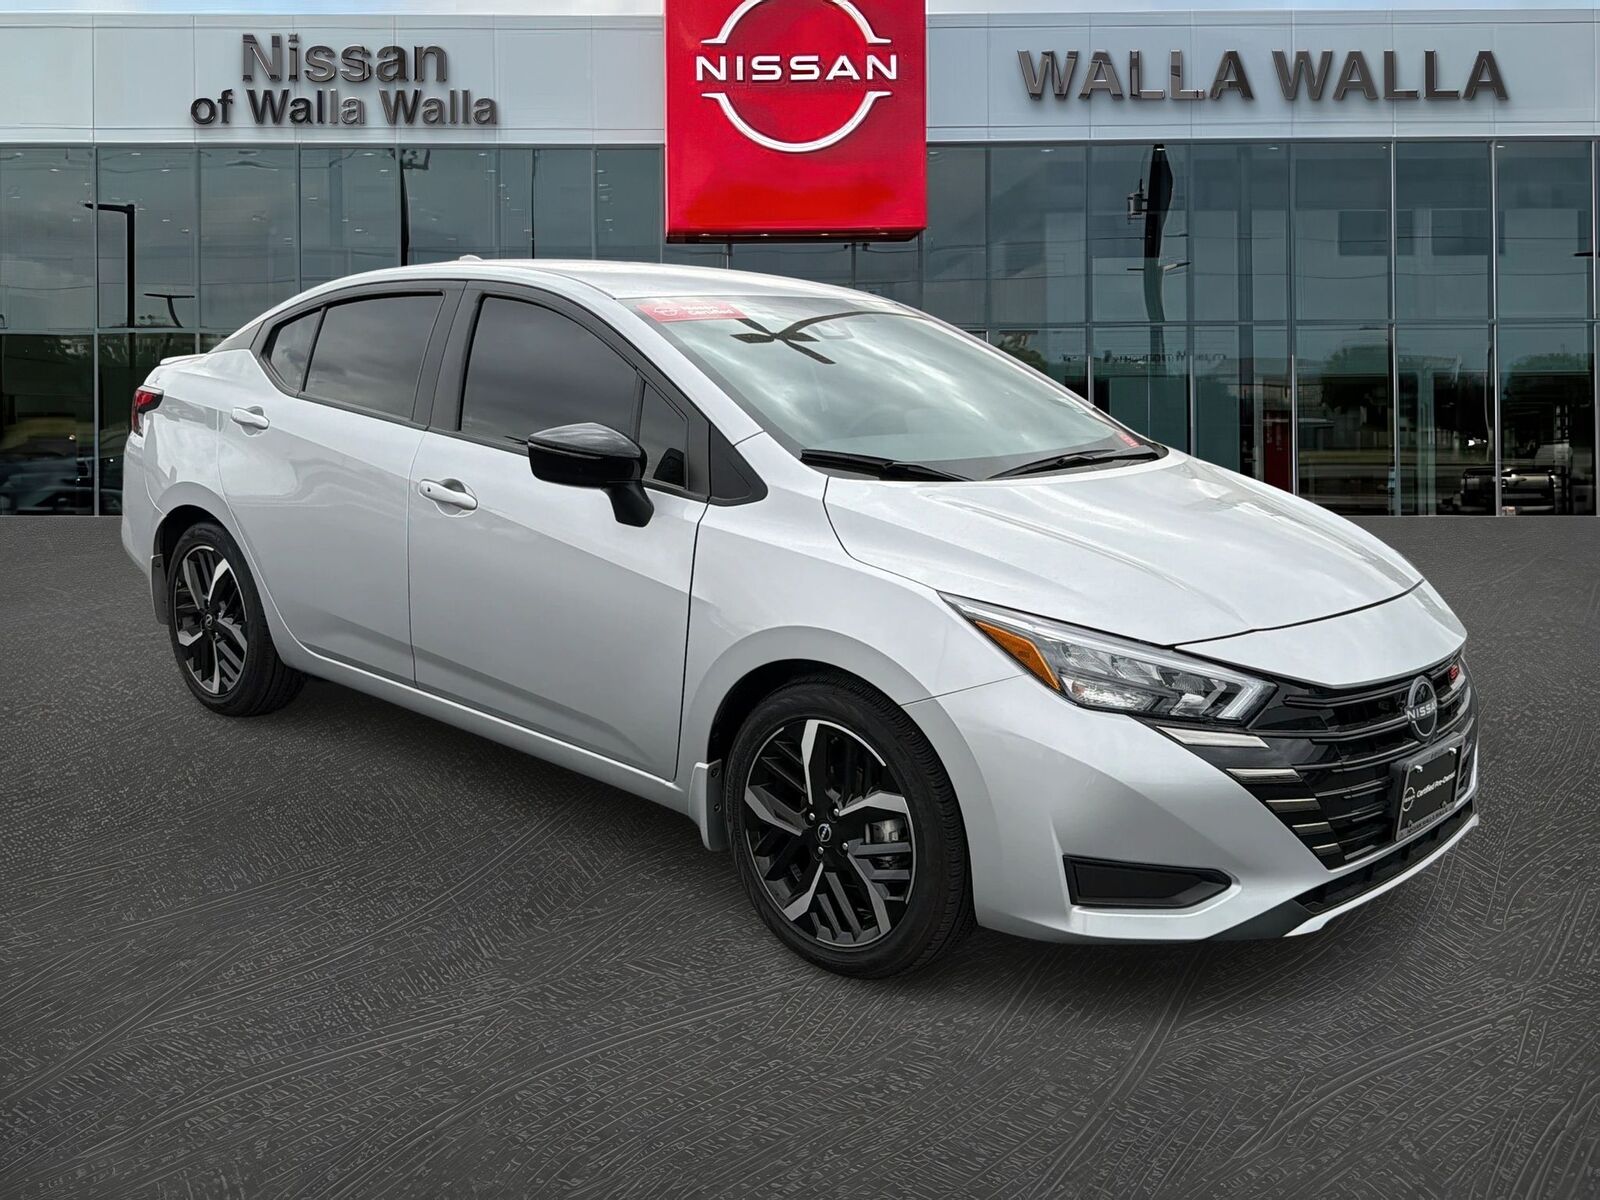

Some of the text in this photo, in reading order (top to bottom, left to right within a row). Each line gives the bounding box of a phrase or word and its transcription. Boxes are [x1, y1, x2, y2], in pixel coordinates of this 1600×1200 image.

[241, 33, 447, 83] Nissan
[696, 54, 897, 81] NISSAN
[1017, 49, 1510, 101] WALLA WALLA
[190, 88, 498, 125] of Walla Walla
